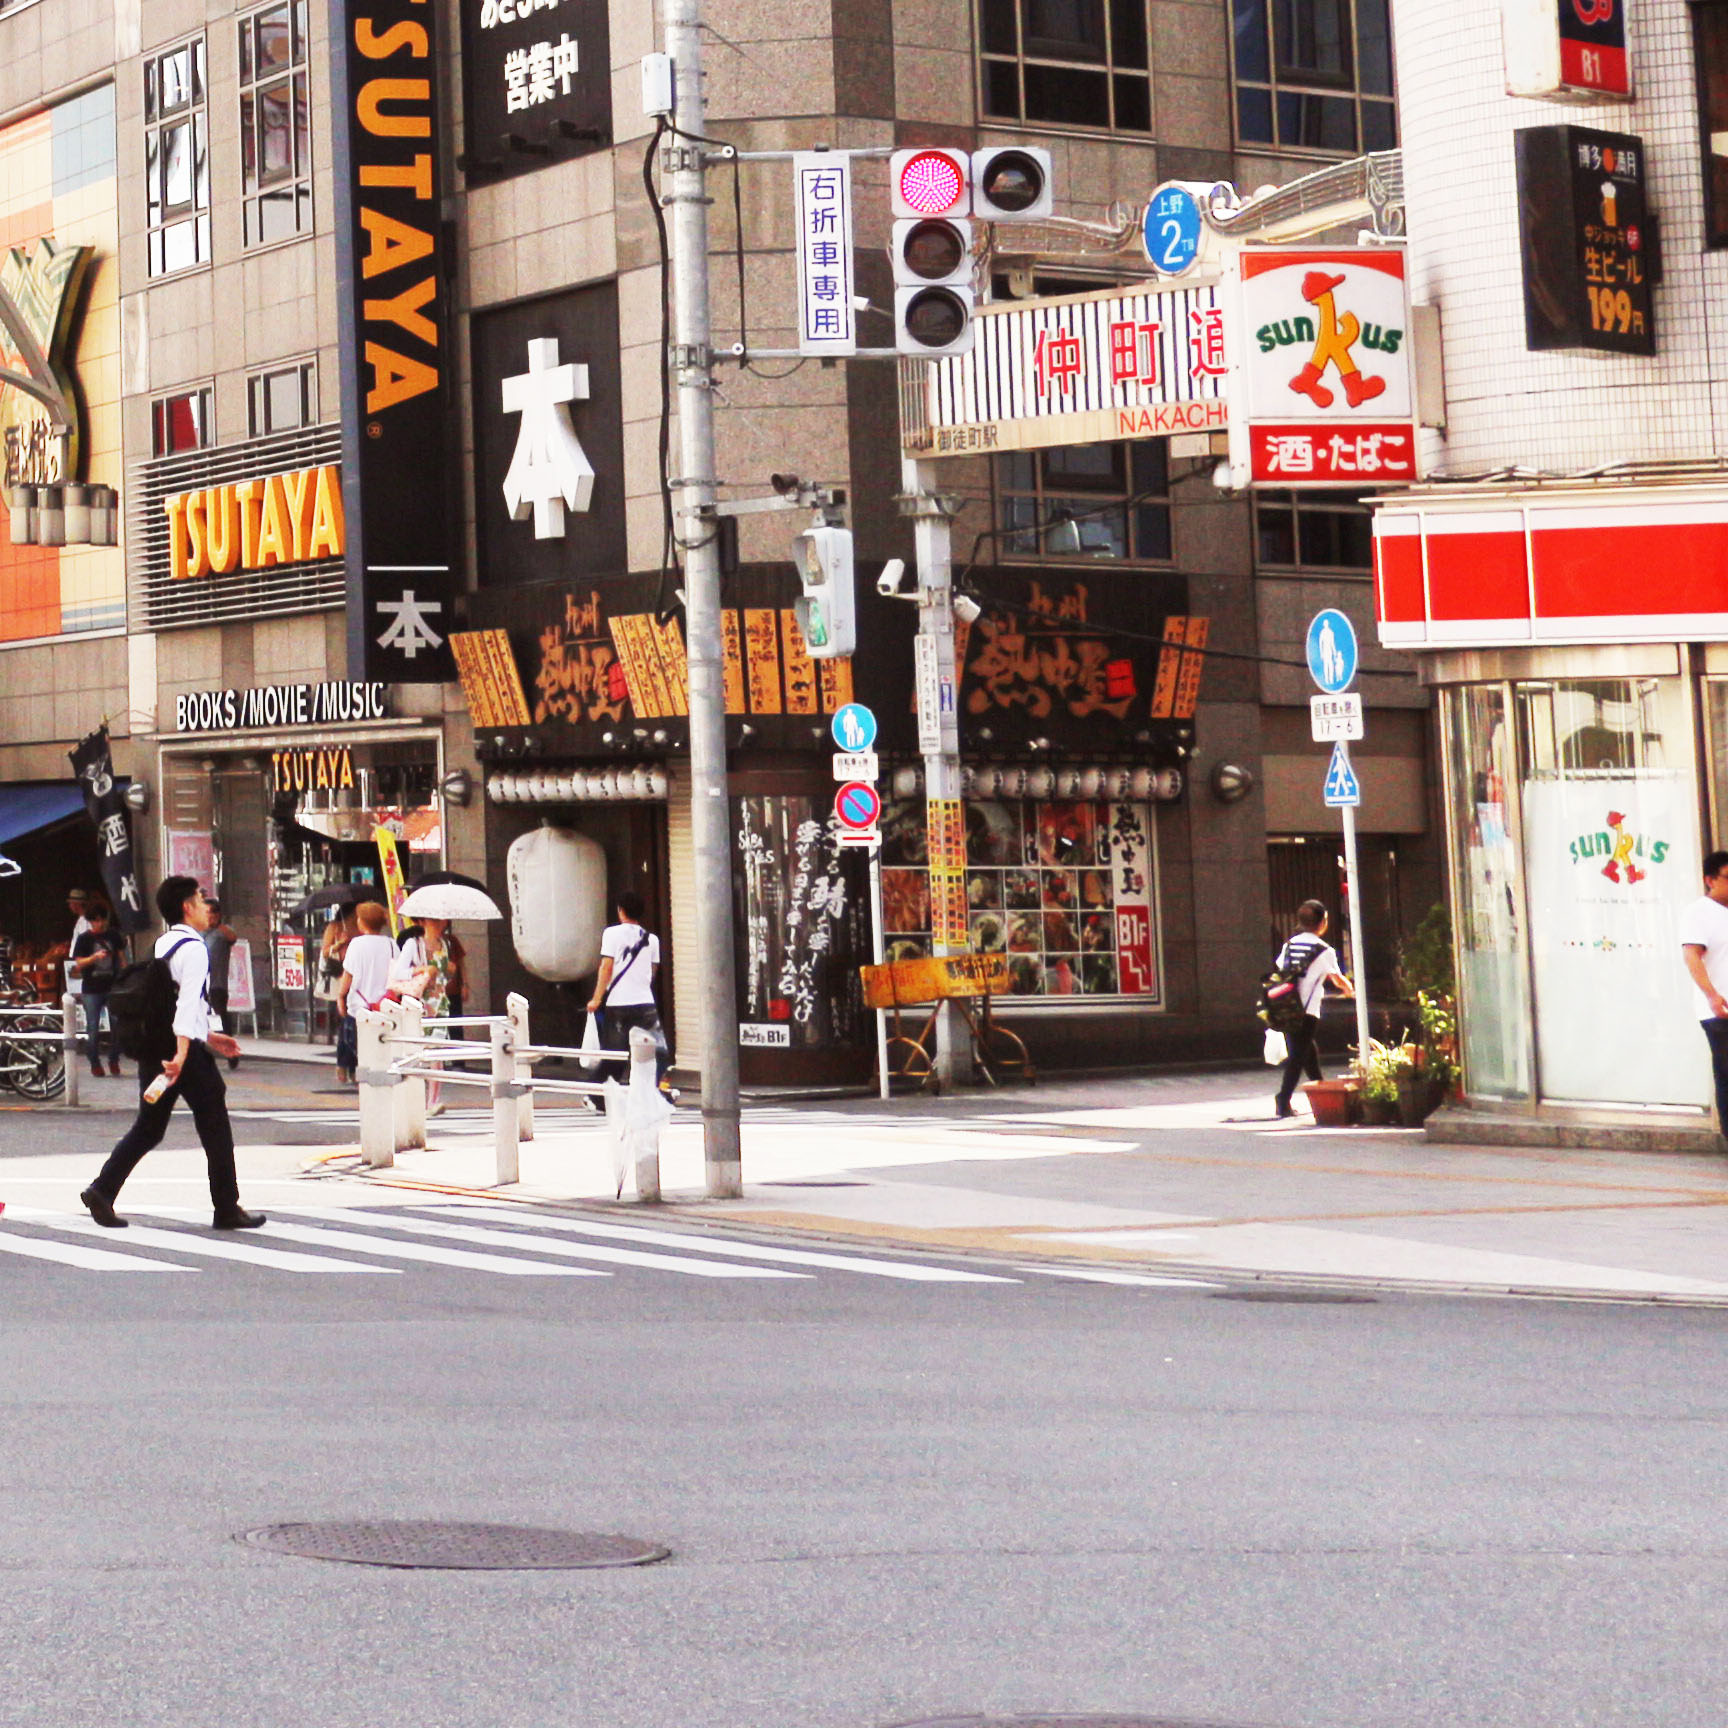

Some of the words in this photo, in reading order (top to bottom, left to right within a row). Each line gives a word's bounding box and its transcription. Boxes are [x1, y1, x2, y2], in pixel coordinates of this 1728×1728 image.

[502, 32, 580, 114] 営業中
[1580, 48, 1603, 84] B1
[1578, 143, 1602, 173] 博多
[1156, 193, 1184, 218] 上野
[807, 172, 841, 335] 右折車専用
[1161, 218, 1184, 266] 2
[1584, 250, 1643, 286] 生ビール
[1587, 286, 1634, 334] 199
[501, 337, 591, 540] 本
[1265, 434, 1410, 473] 酒・たばこ
[164, 465, 344, 580] TSUTAYA
[376, 589, 445, 658] 本
[176, 692, 236, 731] BOOKS
[272, 749, 354, 792] TSUTAYA
[1118, 912, 1148, 947] B1F
